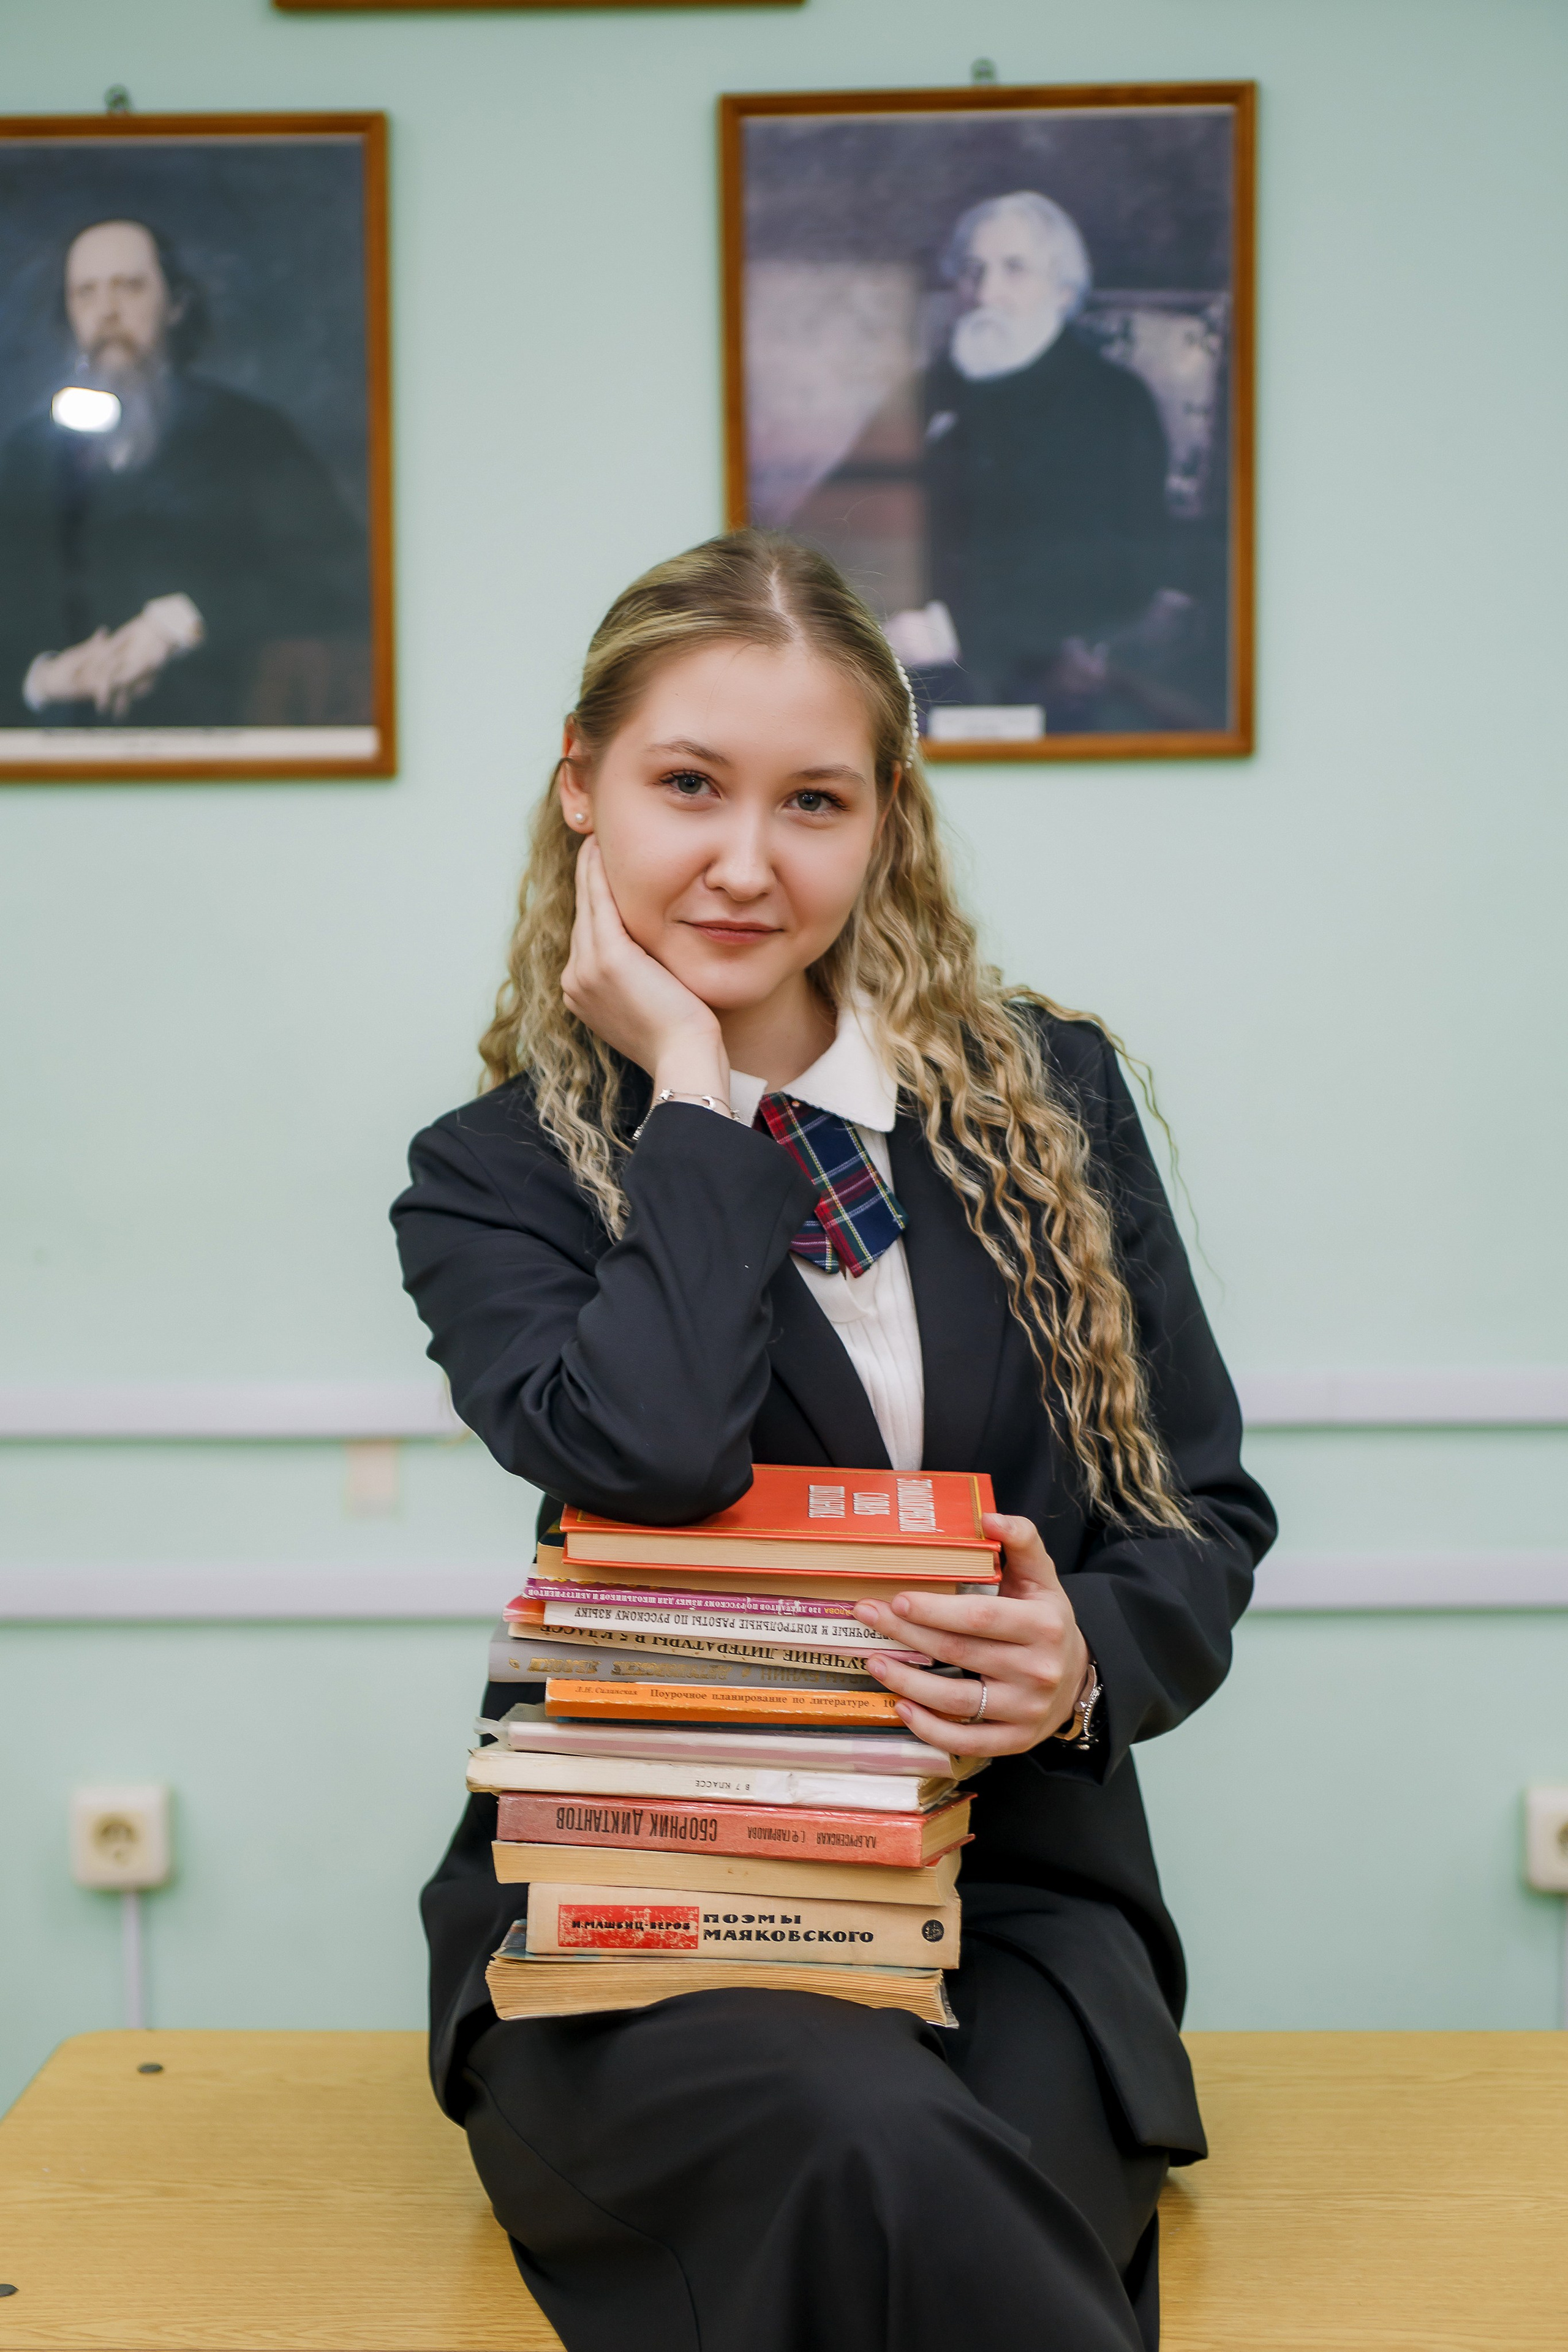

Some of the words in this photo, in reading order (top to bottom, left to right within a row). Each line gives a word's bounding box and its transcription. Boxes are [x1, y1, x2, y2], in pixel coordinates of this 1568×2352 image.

[853, 1492, 890, 1515] СЛОВАРЬ
[528, 1589, 591, 1600] АБИТУРИЕНТОВ
[600, 1593, 656, 1604] ШКОЛЬНИКОВ
[658, 1596, 673, 1605] ДЛЯ
[675, 1598, 703, 1607] ЯЗЫКУ
[704, 1600, 745, 1609] РУССКОМУ
[760, 1603, 806, 1612] ДИКТАНТОВ
[575, 1607, 611, 1619] ЯЗЫКУ
[615, 1610, 671, 1623] РУССКОМУ
[674, 1614, 688, 1625] ПО
[692, 1616, 735, 1628] РАБОТЫ
[739, 1619, 817, 1635] КОНТРОЛЬНЫЕ
[821, 1626, 827, 1634] И
[832, 1626, 895, 1640] ЕРОЧНЫЕ
[652, 1637, 778, 1660] ЛИТЕРАТУРЫ
[783, 1649, 869, 1670] ЗУЧЕНИЕ
[650, 1689, 707, 1701] Поурочное
[712, 1693, 788, 1705] планирование
[883, 1699, 895, 1708] 10
[695, 1781, 731, 1790] КЛАССЕ
[556, 1806, 643, 1836] ДИКТАНТОВ
[649, 1811, 718, 1841] СБОРНИК
[703, 1913, 802, 1924] ПОЭМЫ
[703, 1929, 874, 1943] МАЯКОВСКОГО
